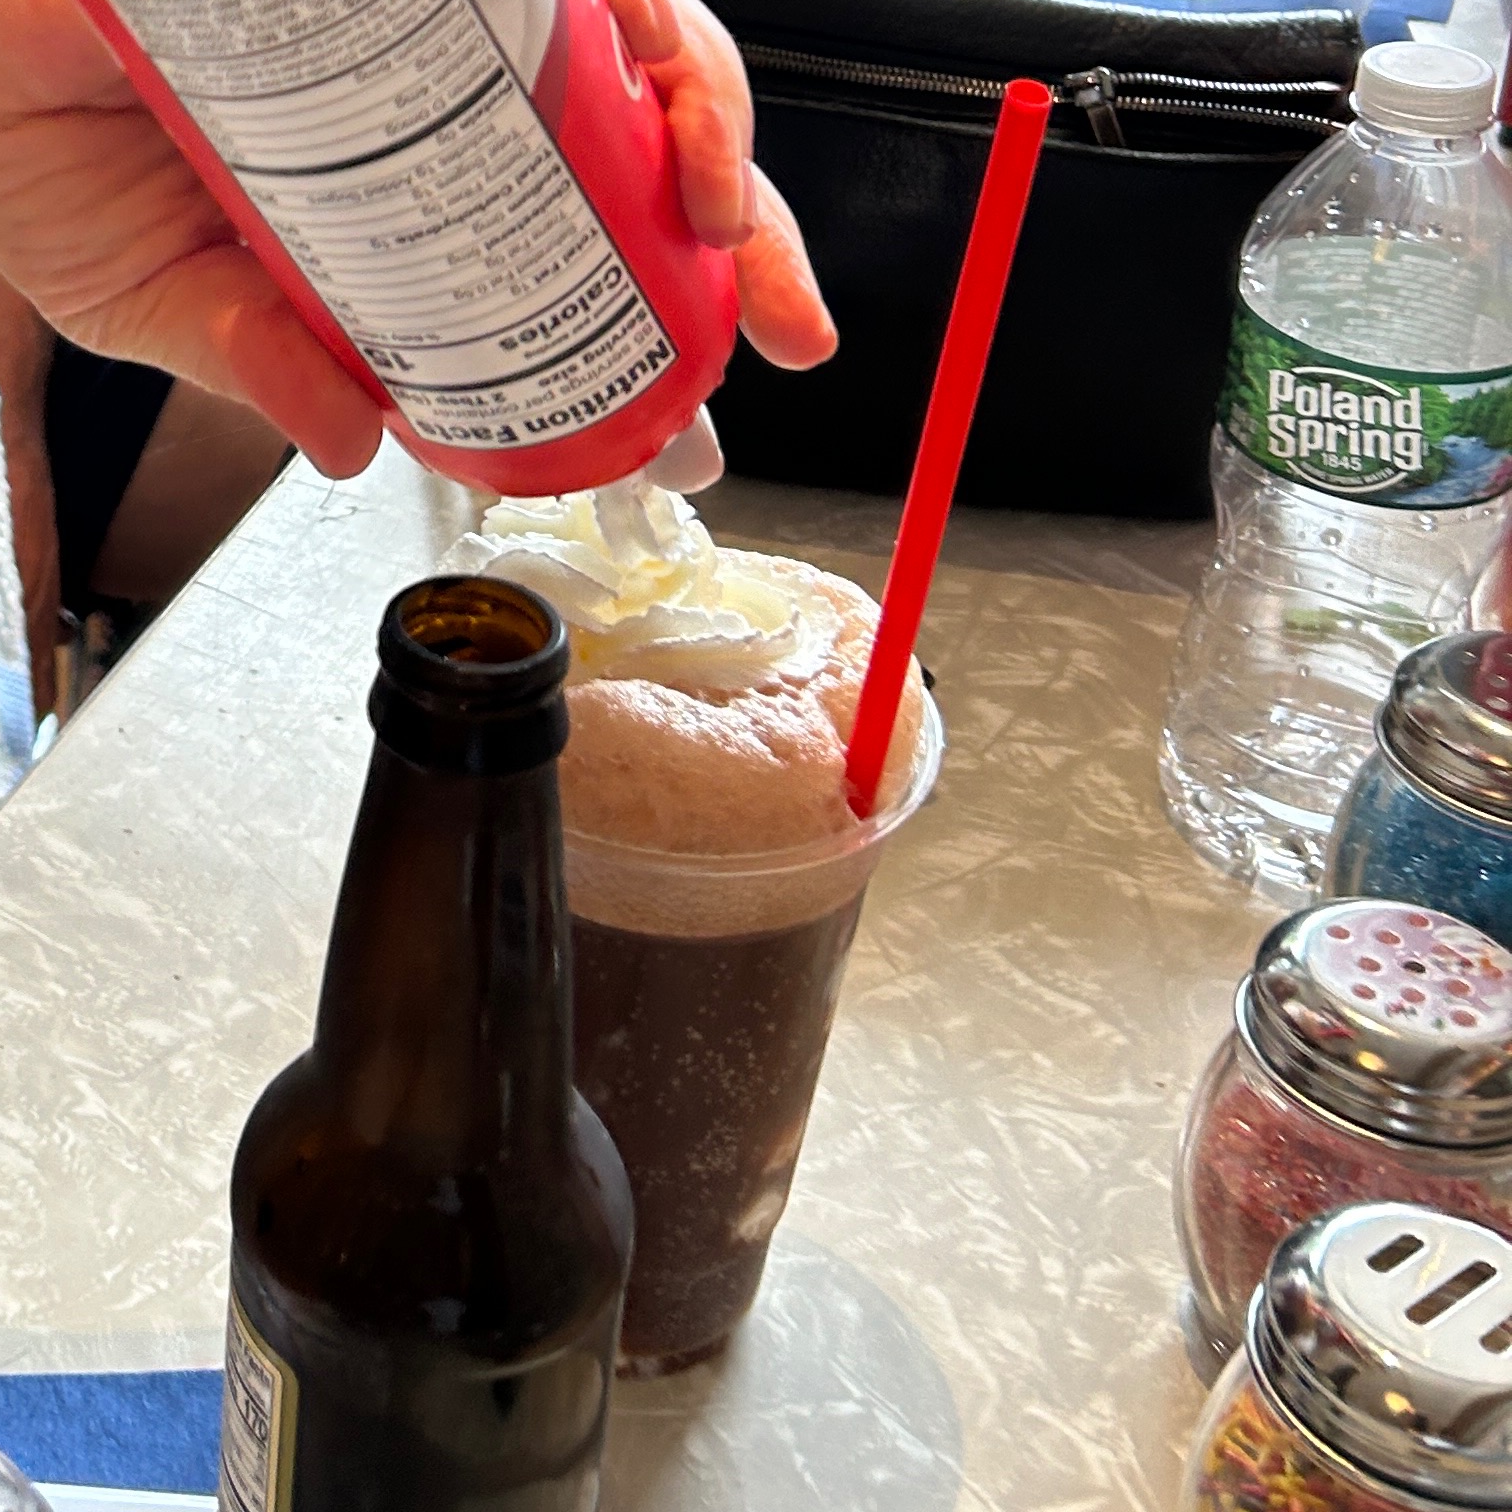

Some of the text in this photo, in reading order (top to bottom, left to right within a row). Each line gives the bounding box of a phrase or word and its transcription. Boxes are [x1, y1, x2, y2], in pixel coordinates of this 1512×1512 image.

[458, 79, 512, 130] Protein
[515, 149, 551, 185] Total
[506, 163, 560, 213] Sodium
[394, 183, 513, 242] Carbohydrate
[484, 178, 570, 250] Cholesterol
[507, 238, 530, 258] Fat
[562, 228, 597, 263] Total
[489, 270, 514, 289] Fat
[533, 262, 560, 283] Fat
[364, 265, 622, 371] Calories 15
[581, 308, 647, 365] Serving
[536, 362, 578, 388] size
[558, 343, 631, 395] servings
[415, 338, 669, 442] Nutrition Facts
[435, 395, 489, 406] Tbsp
[491, 390, 506, 404] 2
[524, 390, 555, 408] per
[1268, 369, 1424, 431] Poland
[433, 402, 519, 416] container
[1266, 413, 1425, 472] Spring
[1321, 452, 1364, 472] 1845
